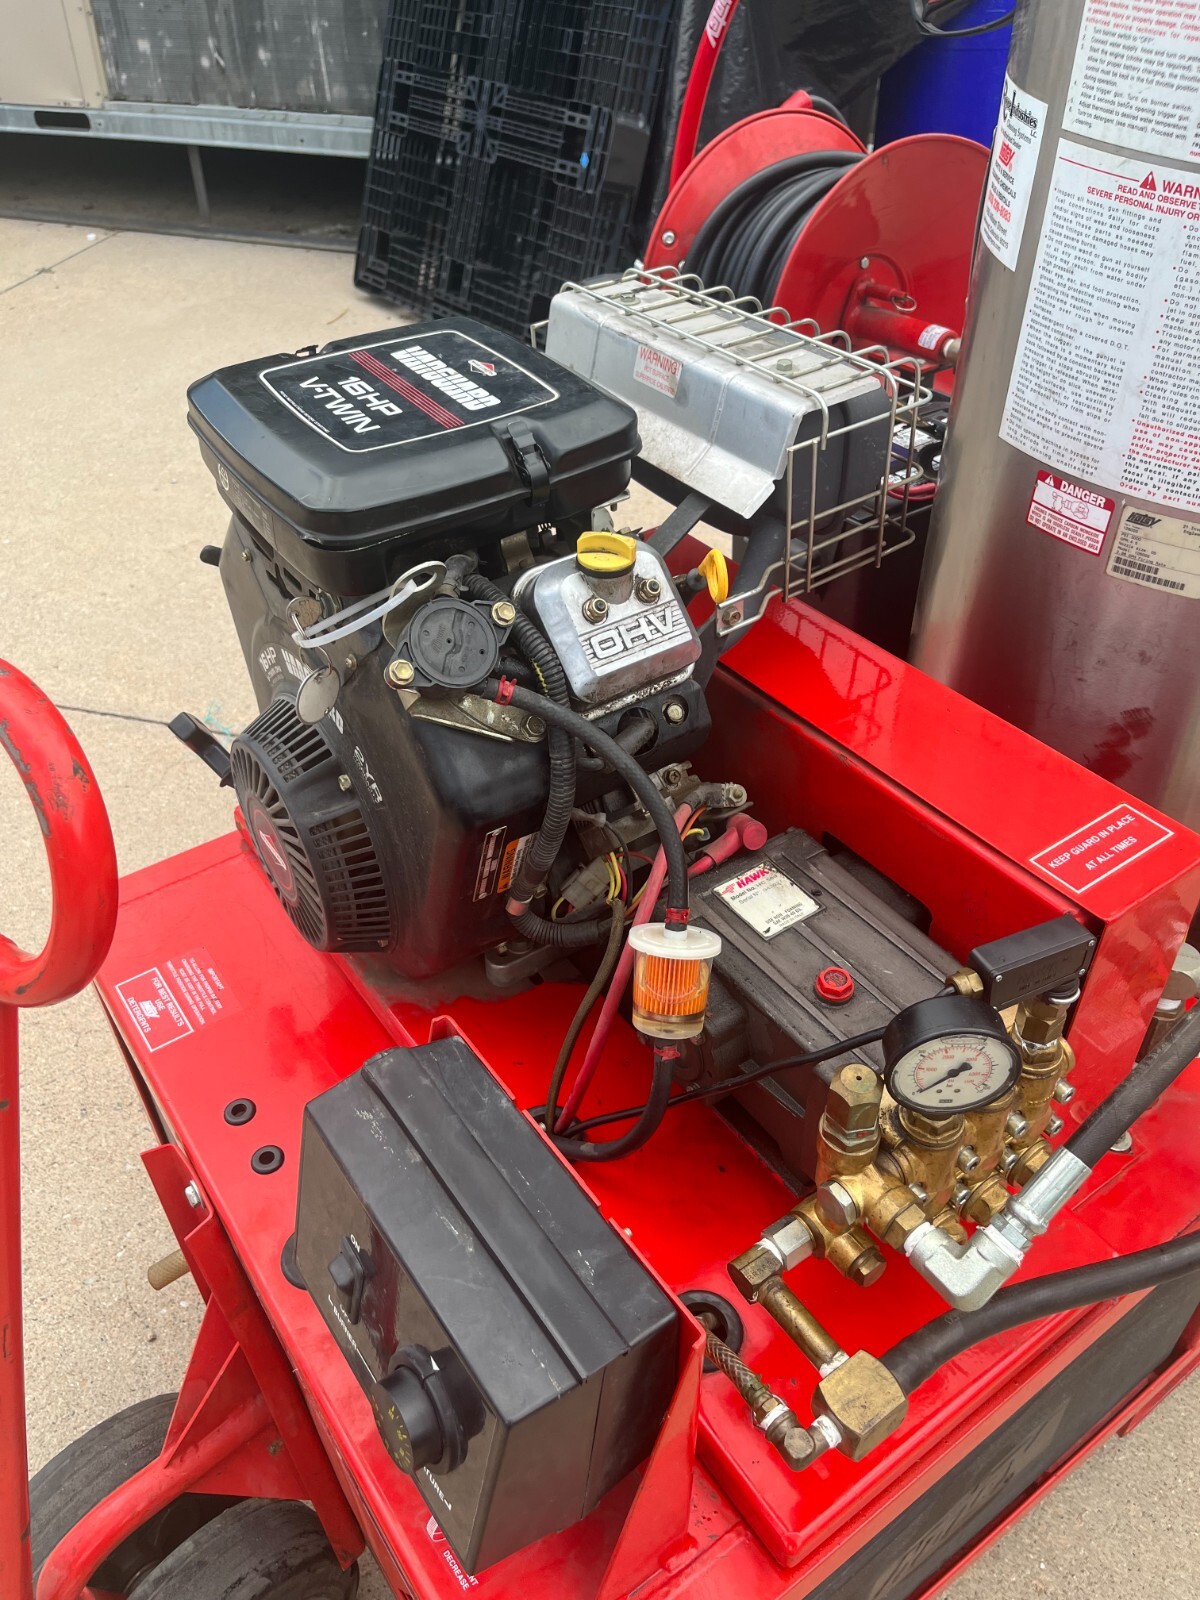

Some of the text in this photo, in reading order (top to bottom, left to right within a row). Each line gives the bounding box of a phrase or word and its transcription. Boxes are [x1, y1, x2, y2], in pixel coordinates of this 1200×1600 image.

[1087, 186, 1112, 200] SEVERE
[1113, 193, 1154, 212] PERSONAL
[1156, 204, 1186, 218] INJURY
[1118, 184, 1138, 196] READ
[1139, 189, 1156, 200] AND
[1158, 195, 1197, 210] OBSERVE
[1188, 224, 1199, 233] Do
[1177, 266, 1189, 274] Do
[1169, 298, 1196, 310] Do not
[1164, 314, 1184, 325] Keep
[1156, 345, 1169, 354] For
[1173, 341, 1194, 351] motor
[1154, 352, 1182, 365] manual
[390, 346, 501, 411] VANGUARD
[1146, 382, 1167, 395] safety
[1148, 375, 1169, 385] When
[299, 376, 381, 434] V-TWIN
[338, 376, 402, 416] 16HP
[1144, 390, 1178, 405] Cleaning
[1140, 404, 1157, 413] This
[1142, 397, 1197, 418] with adequate
[1136, 419, 1185, 438] Unauthorized
[1132, 434, 1173, 451] parts may
[1126, 454, 1138, 462] Do
[1139, 457, 1152, 466] not
[1128, 448, 1190, 470] the manufacturer
[1155, 448, 1188, 463] property
[1120, 474, 1161, 492] replace by
[1122, 467, 1144, 478] decal
[1157, 477, 1191, 493] illegible
[1124, 461, 1140, 470] this
[1182, 476, 1198, 487] any
[1060, 480, 1106, 508] DANGER
[1119, 481, 1180, 504] Order by part
[590, 606, 674, 659] OHV
[1048, 814, 1136, 869] KEEP GUARD IN PLACE
[1084, 836, 1138, 871] AT ALL TIMES
[736, 866, 770, 889] HAWK
[151, 976, 185, 1027] FOR BEST RESULTS
[153, 998, 166, 1011] USE
[126, 996, 152, 1033] DETERGENTS
[350, 1234, 360, 1252] ON
[443, 1550, 470, 1591] DECREASE
